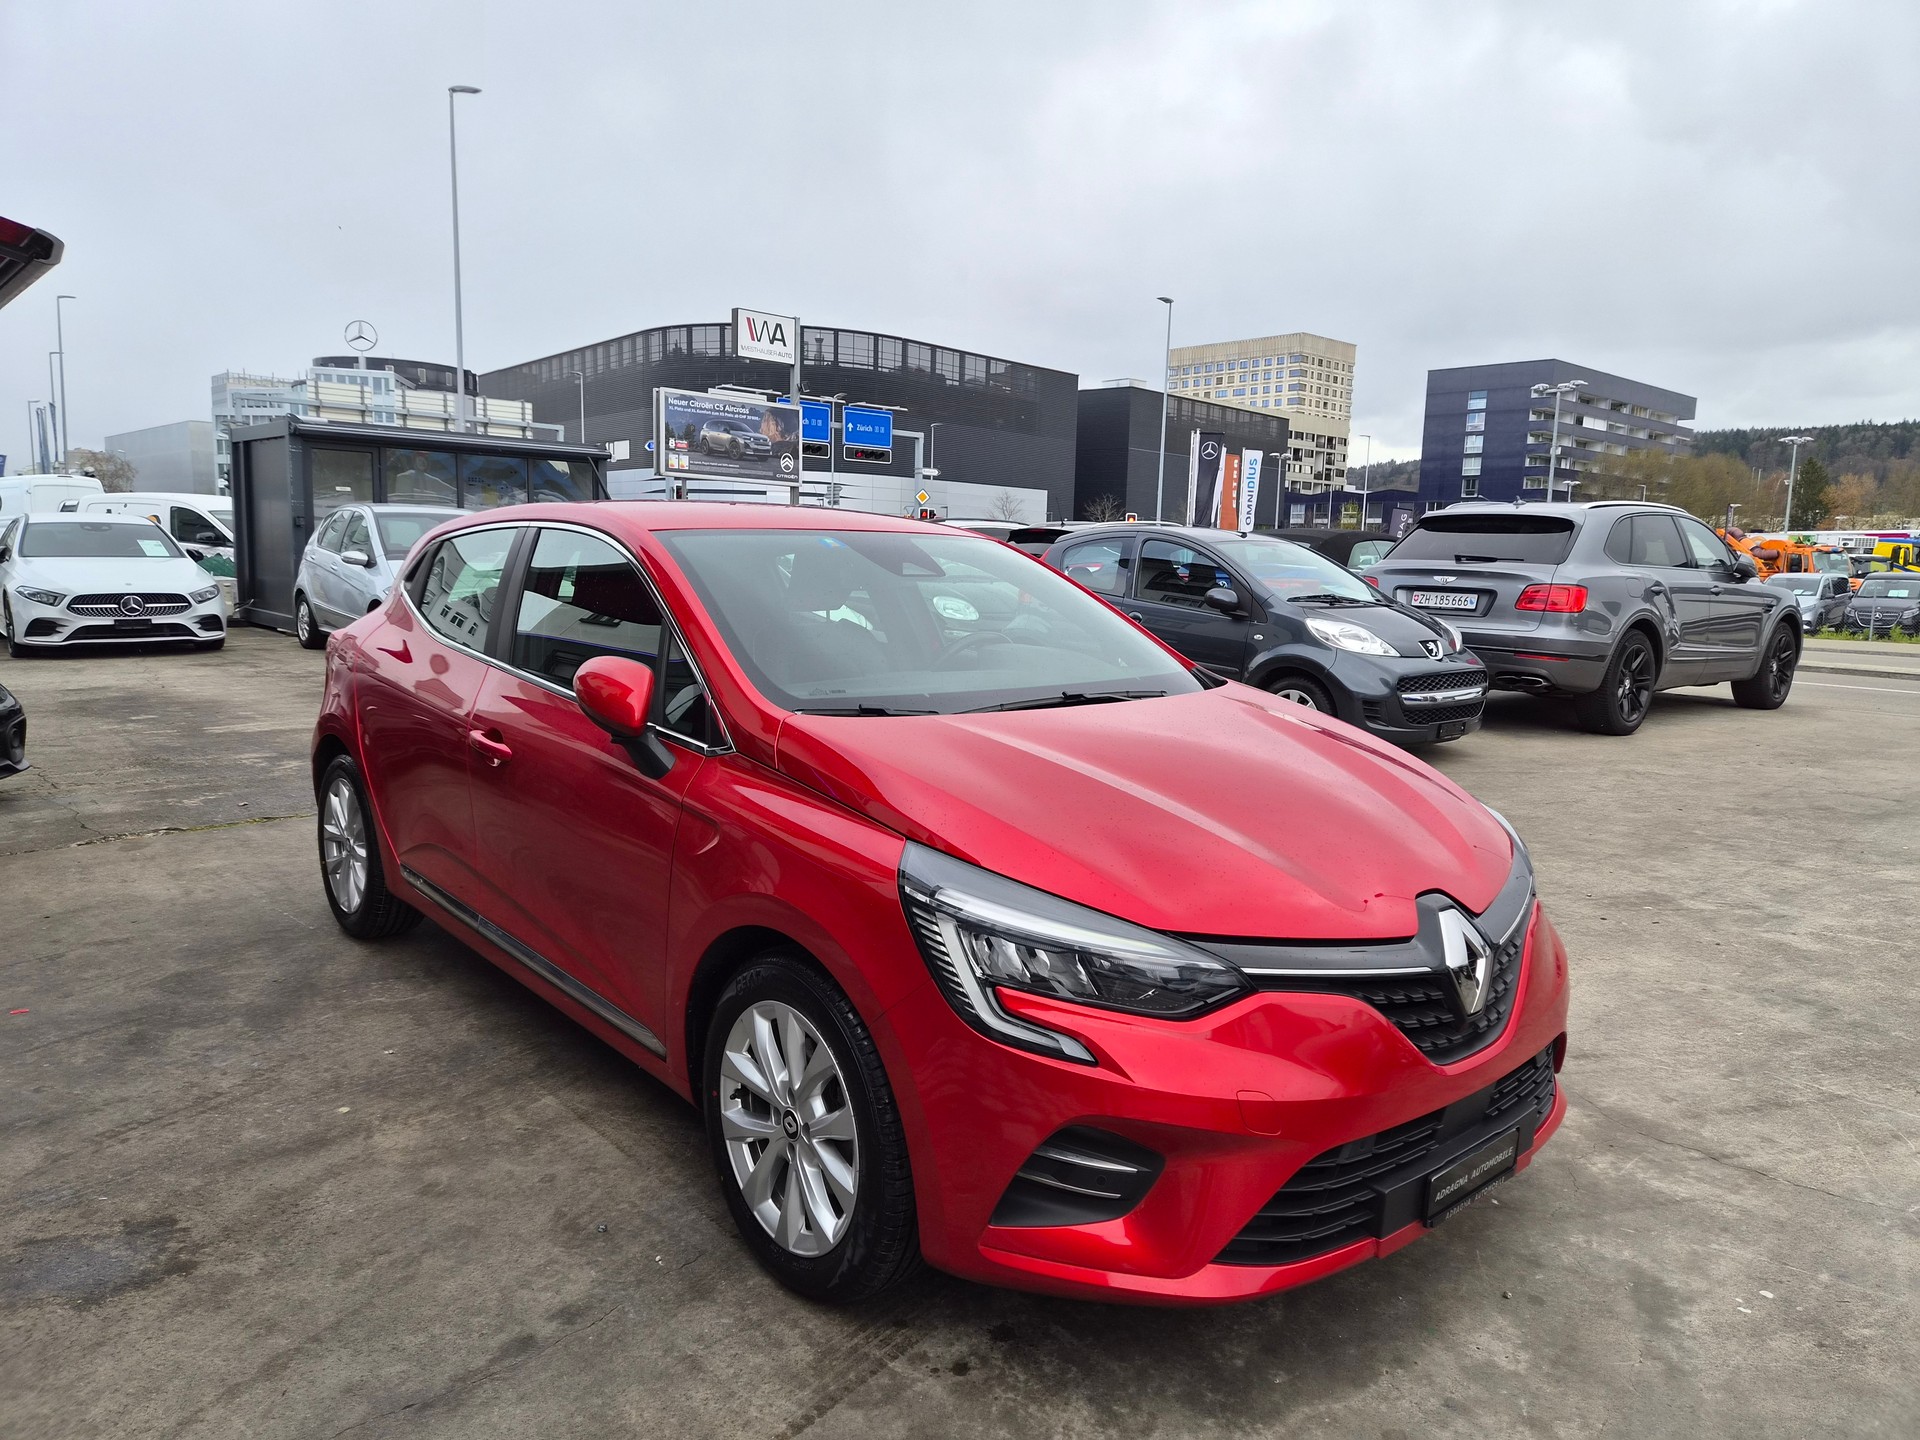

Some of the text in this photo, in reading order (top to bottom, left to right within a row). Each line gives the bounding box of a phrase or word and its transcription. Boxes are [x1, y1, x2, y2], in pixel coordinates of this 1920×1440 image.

[668, 397, 750, 414] Neuer Citroën C5 Aircross
[856, 423, 873, 432] Zürich
[1245, 458, 1258, 526] OMNIDIUS
[1434, 1146, 1514, 1202] ADRAGNA AUTOMOBILE
